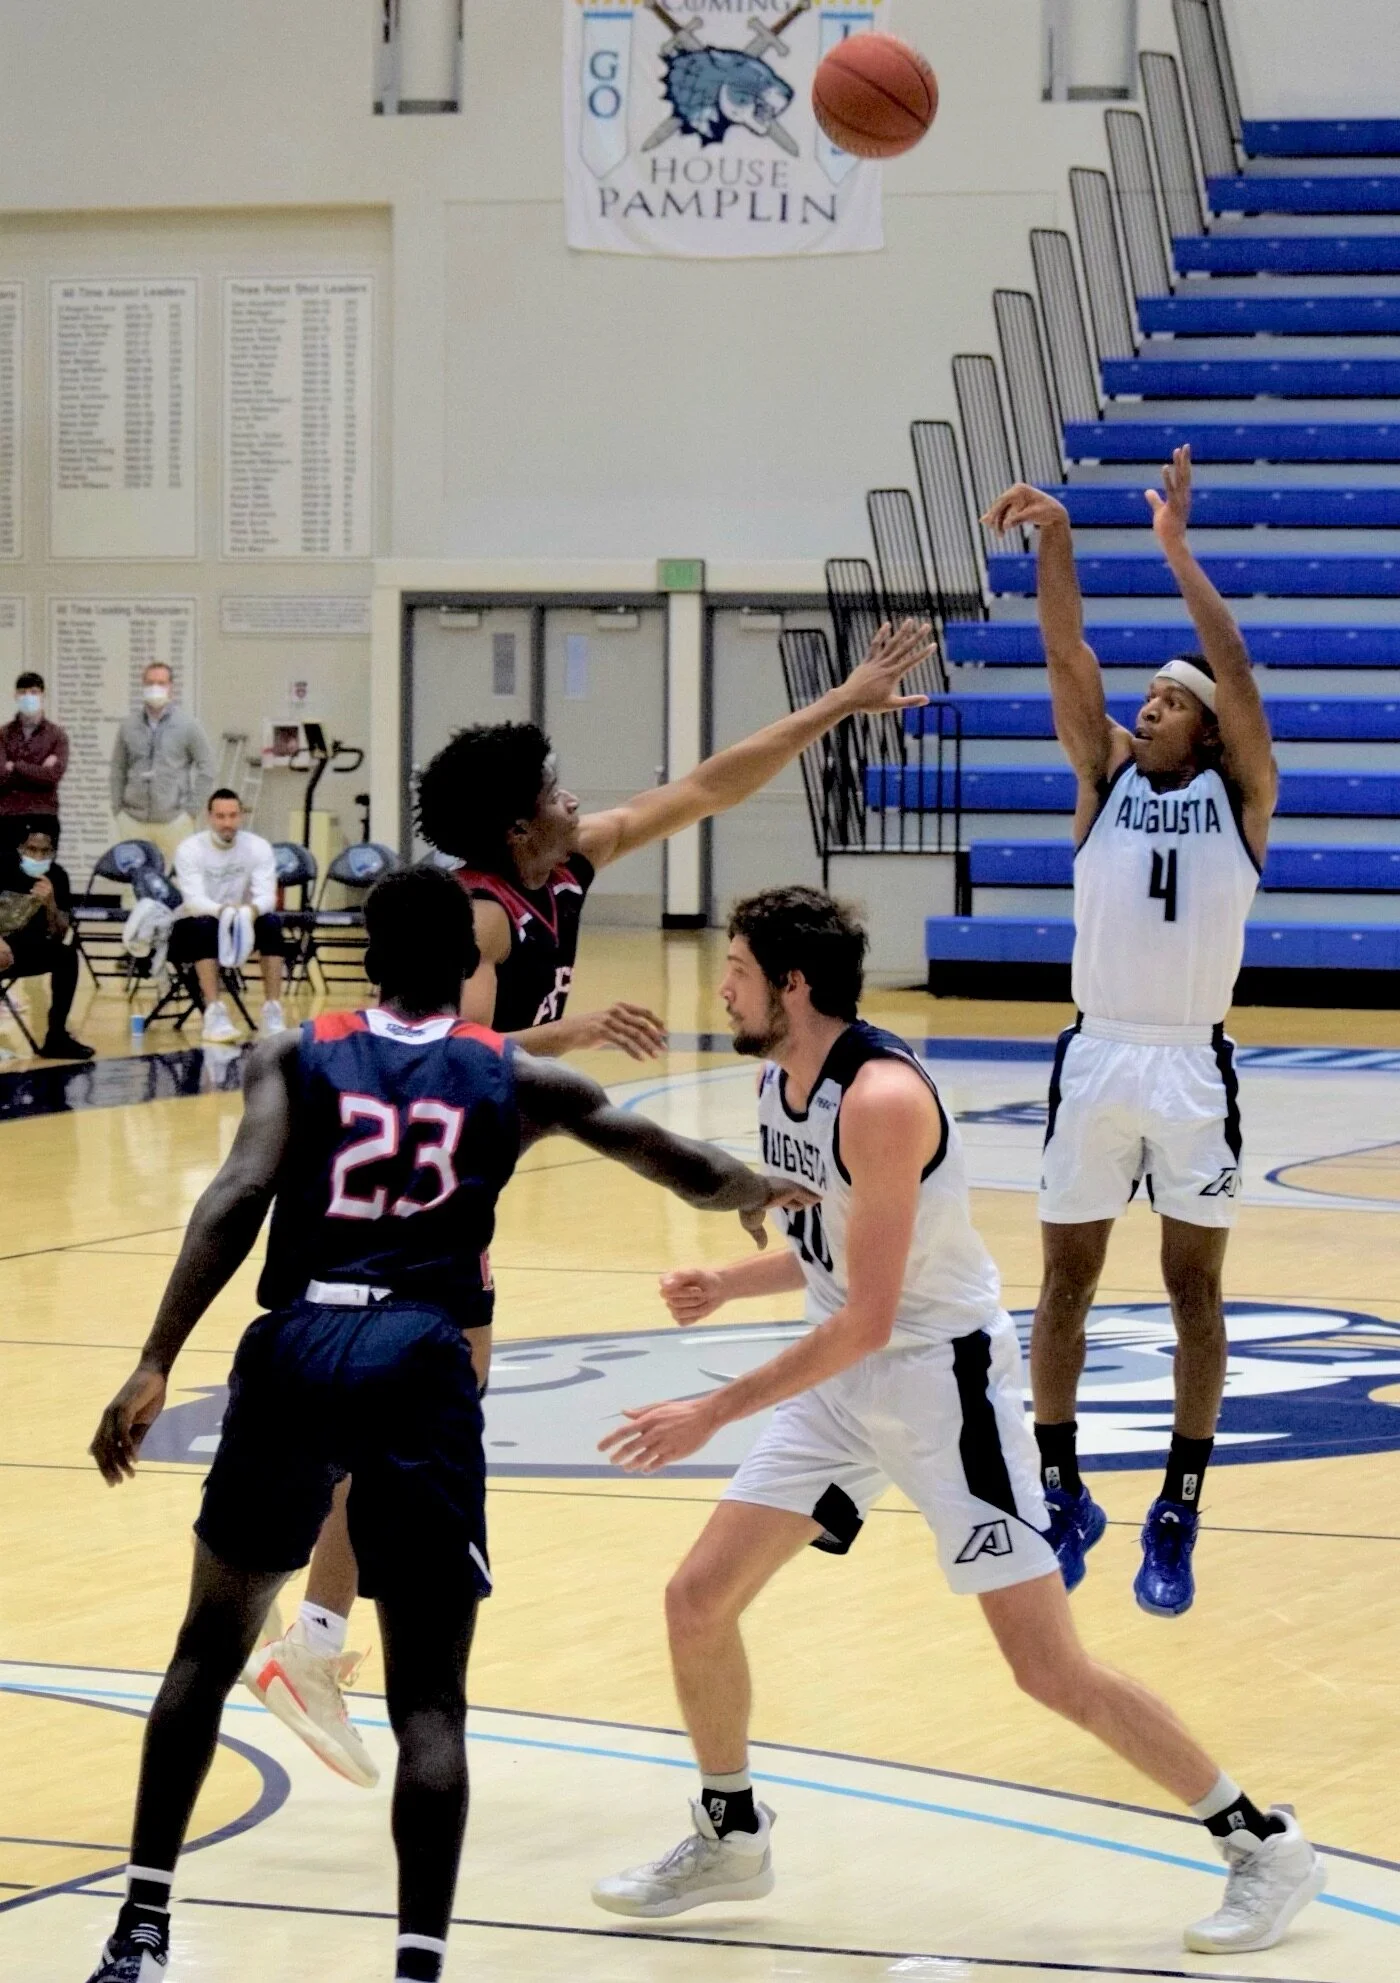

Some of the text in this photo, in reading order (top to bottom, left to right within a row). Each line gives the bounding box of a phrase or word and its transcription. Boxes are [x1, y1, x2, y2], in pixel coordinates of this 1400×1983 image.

[650, 156, 789, 189] HOUSE
[598, 187, 837, 224] PAMPLIN
[79, 287, 103, 298] Time
[143, 286, 186, 298] Leaders
[263, 283, 290, 294] Point
[71, 604, 92, 615] Time
[95, 604, 131, 617] Leading
[134, 604, 188, 616] Rebounders
[1115, 795, 1221, 834] AUGUSTA
[1149, 848, 1177, 922] 4
[325, 1092, 464, 1220] 23
